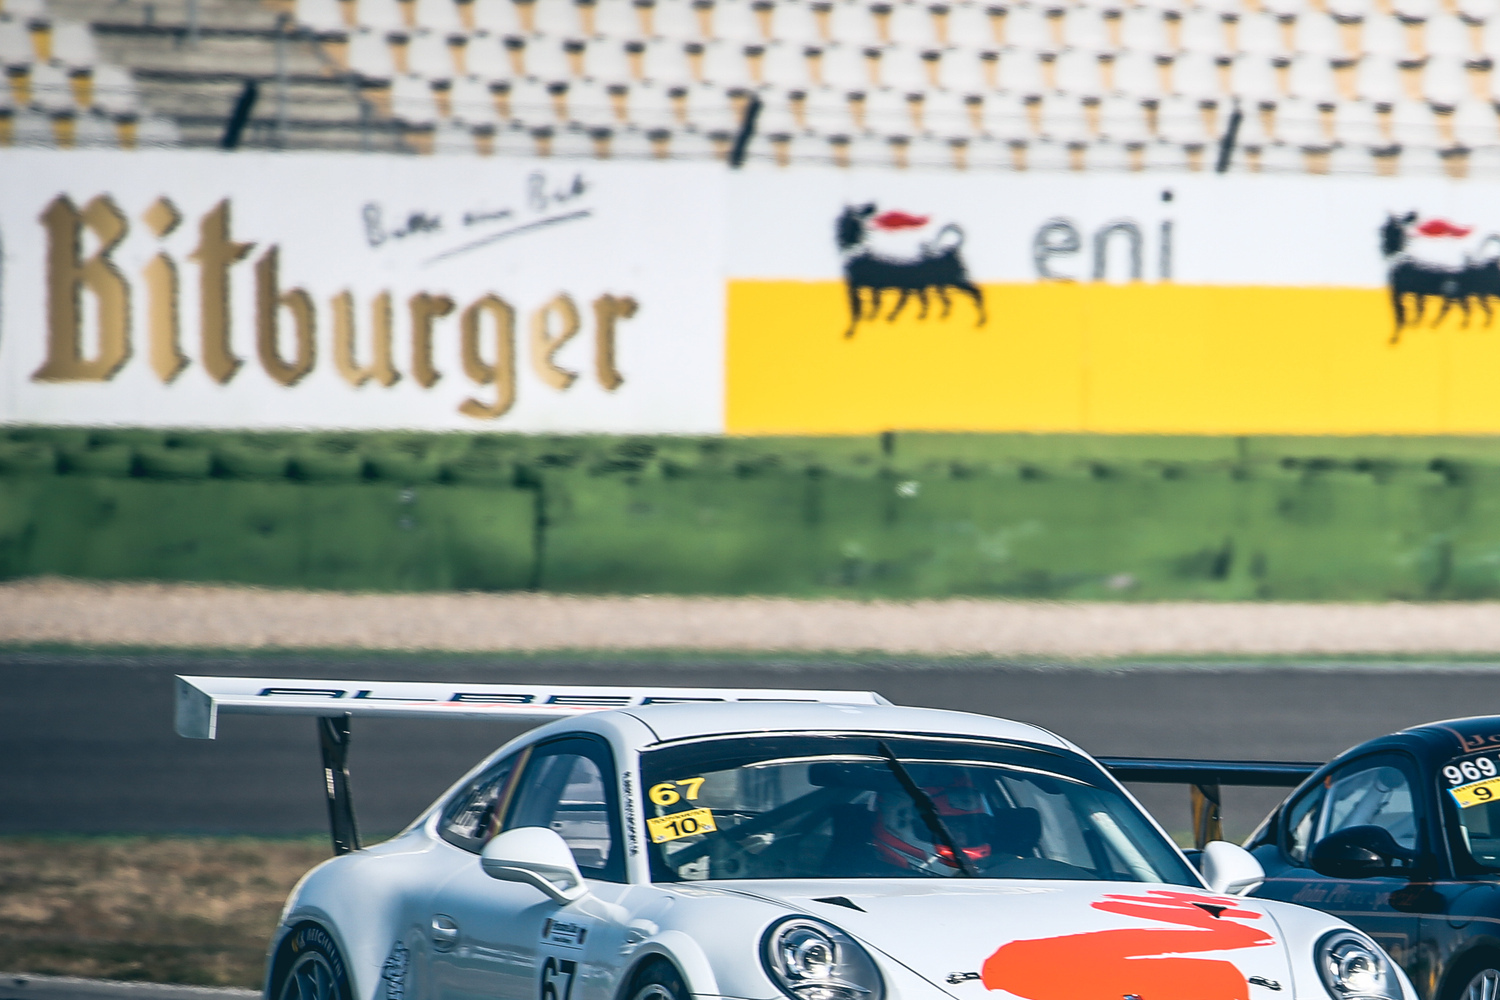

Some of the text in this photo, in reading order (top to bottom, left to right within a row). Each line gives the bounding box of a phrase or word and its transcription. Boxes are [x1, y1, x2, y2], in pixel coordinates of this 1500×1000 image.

[1032, 189, 1174, 282] eni
[31, 192, 640, 420] Bitburger
[1442, 756, 1498, 786] 969
[648, 777, 706, 806] 67
[1473, 786, 1493, 801] 9
[664, 817, 698, 837] 10
